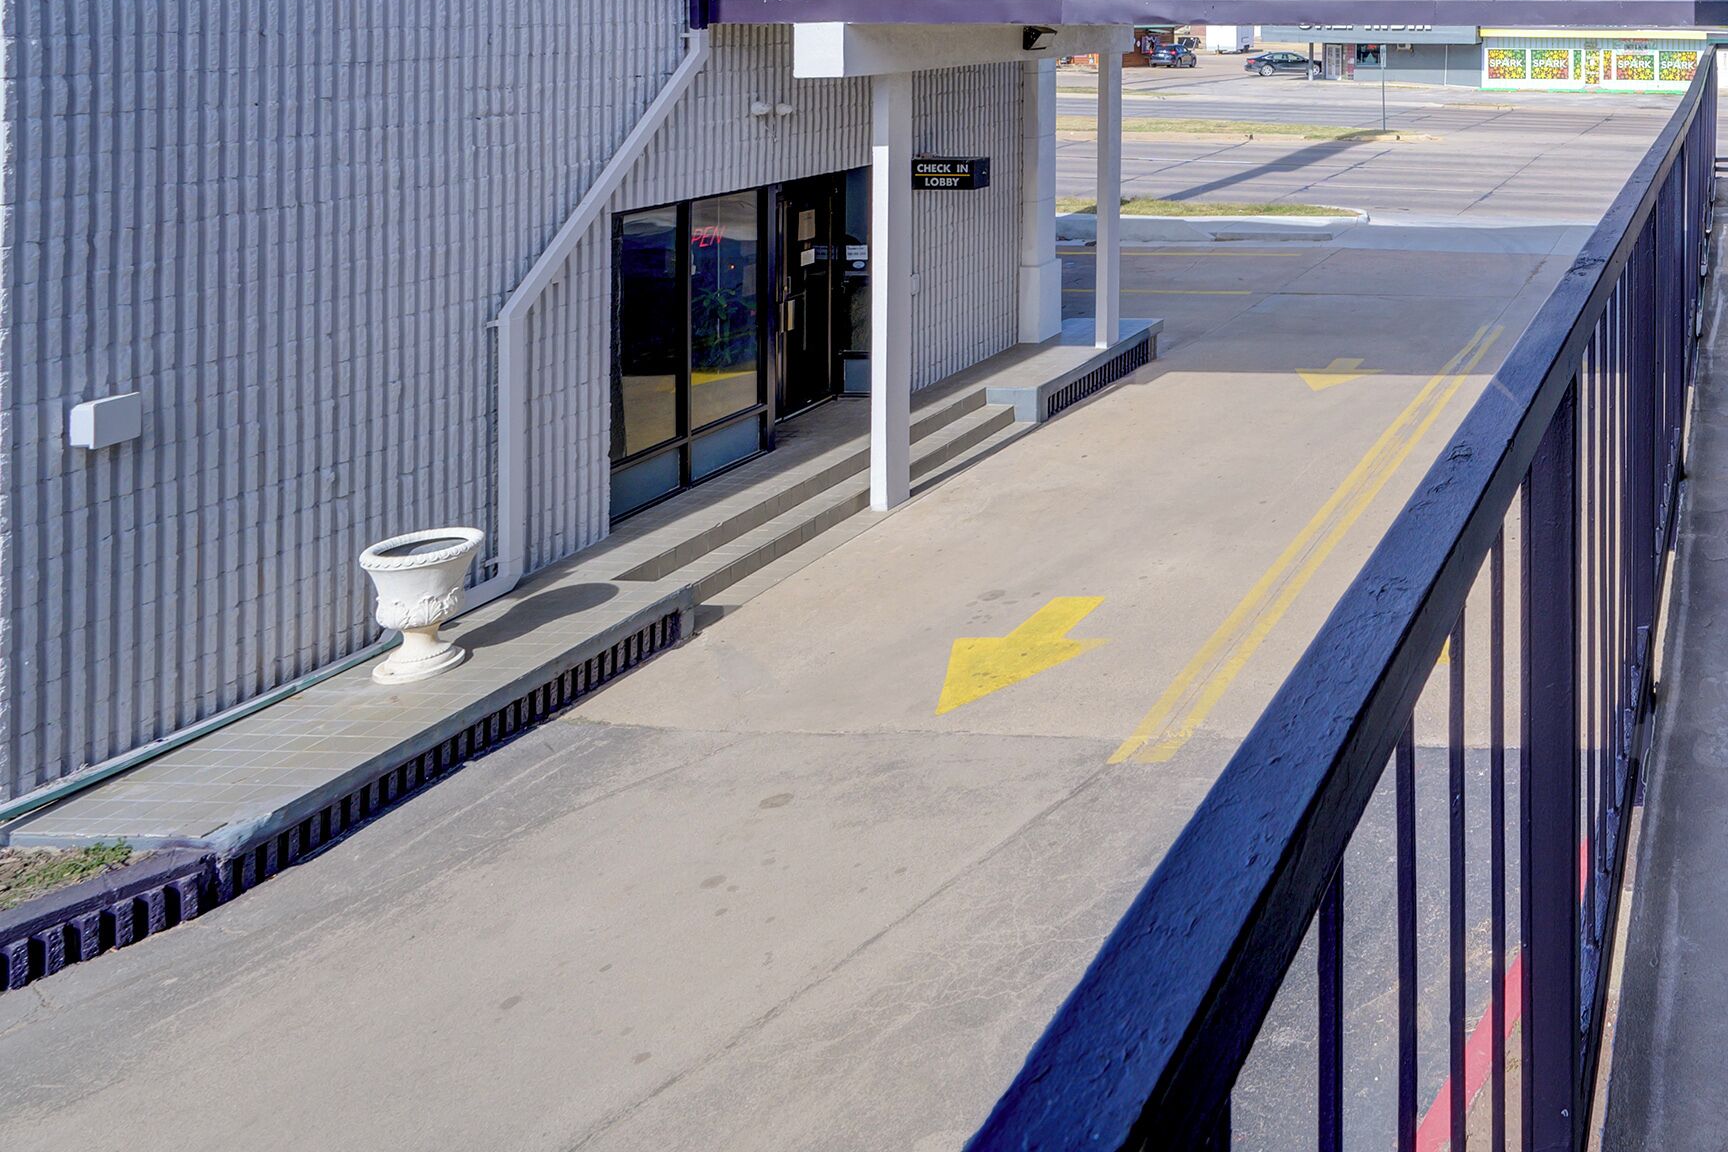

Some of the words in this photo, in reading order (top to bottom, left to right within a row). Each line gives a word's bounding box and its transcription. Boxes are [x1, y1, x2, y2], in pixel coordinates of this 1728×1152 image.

[1489, 57, 1523, 67] SPARK
[1533, 57, 1567, 68] SPARK
[1617, 59, 1652, 69] SPARK
[1661, 59, 1695, 69] SPARK
[916, 164, 951, 173] CHECK
[956, 164, 969, 173] IN
[924, 177, 960, 187] LOBBY
[691, 224, 727, 248] PEN
